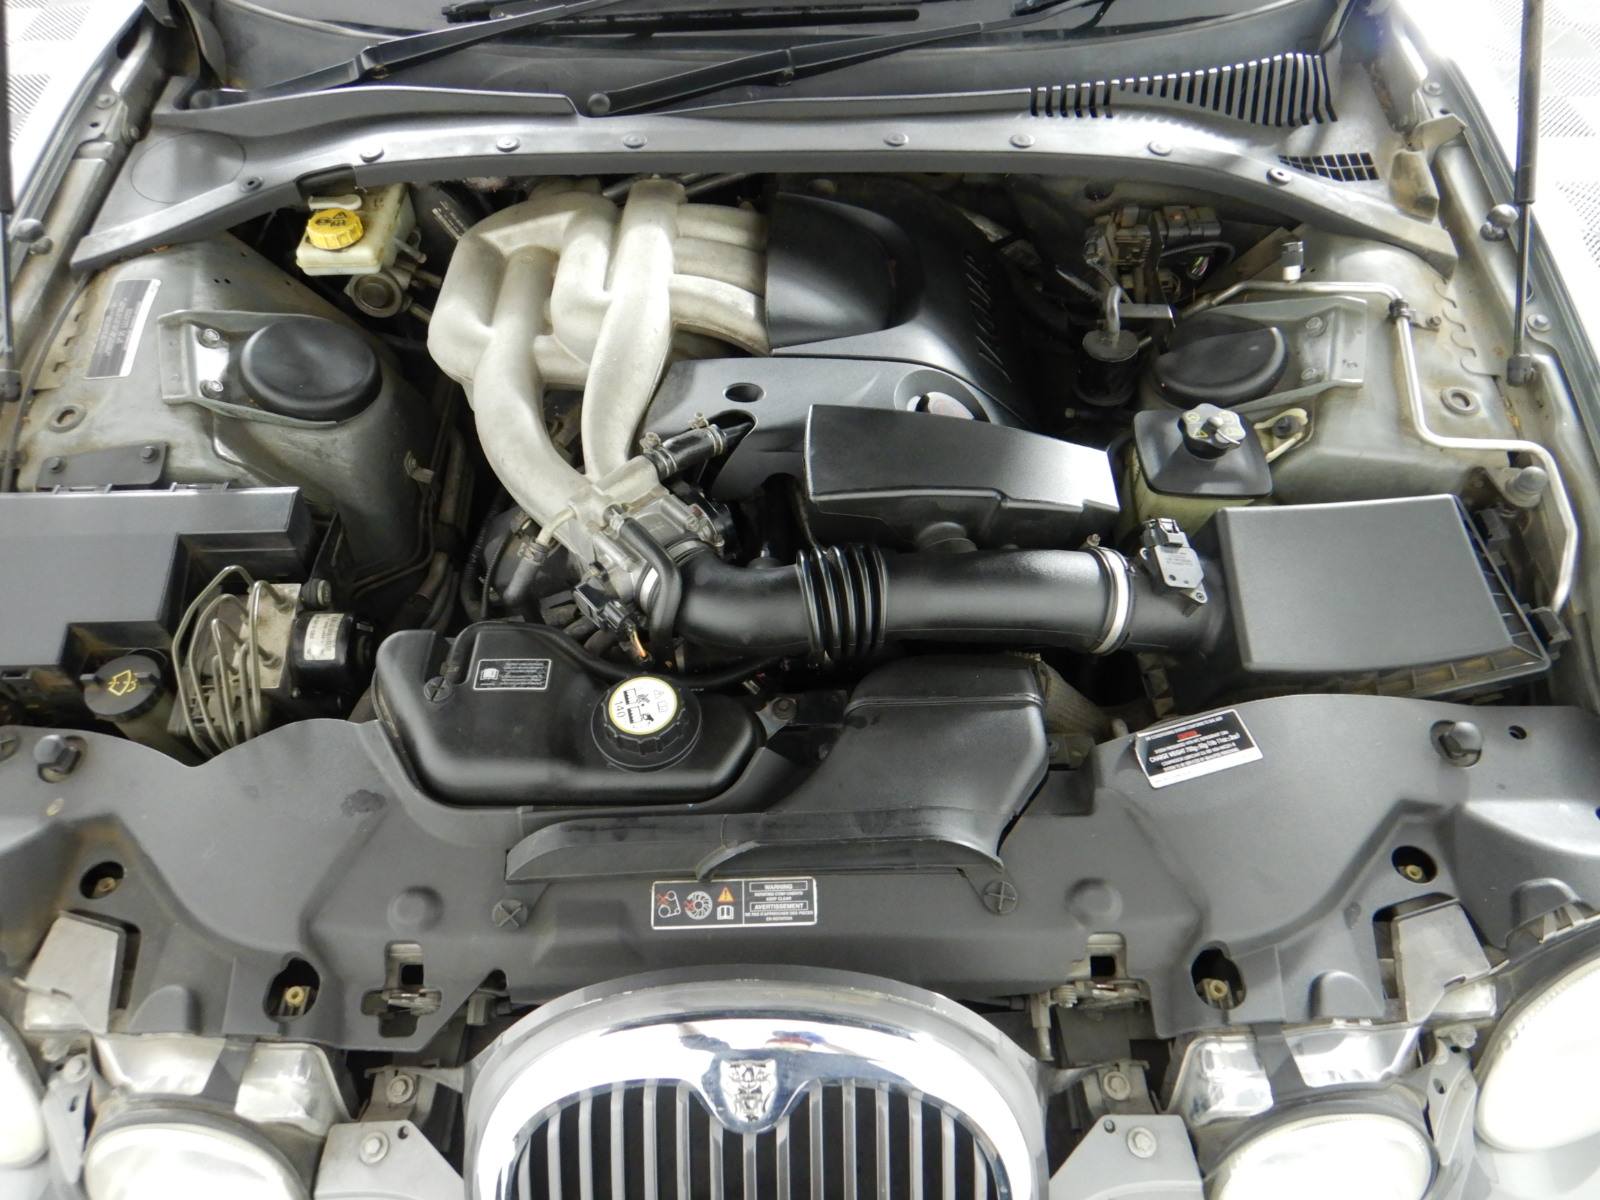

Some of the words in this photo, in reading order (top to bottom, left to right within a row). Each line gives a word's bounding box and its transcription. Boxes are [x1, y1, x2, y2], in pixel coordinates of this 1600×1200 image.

[614, 701, 626, 718] 140
[1149, 753, 1169, 763] CHARGE
[1168, 748, 1186, 758] WEIGHT
